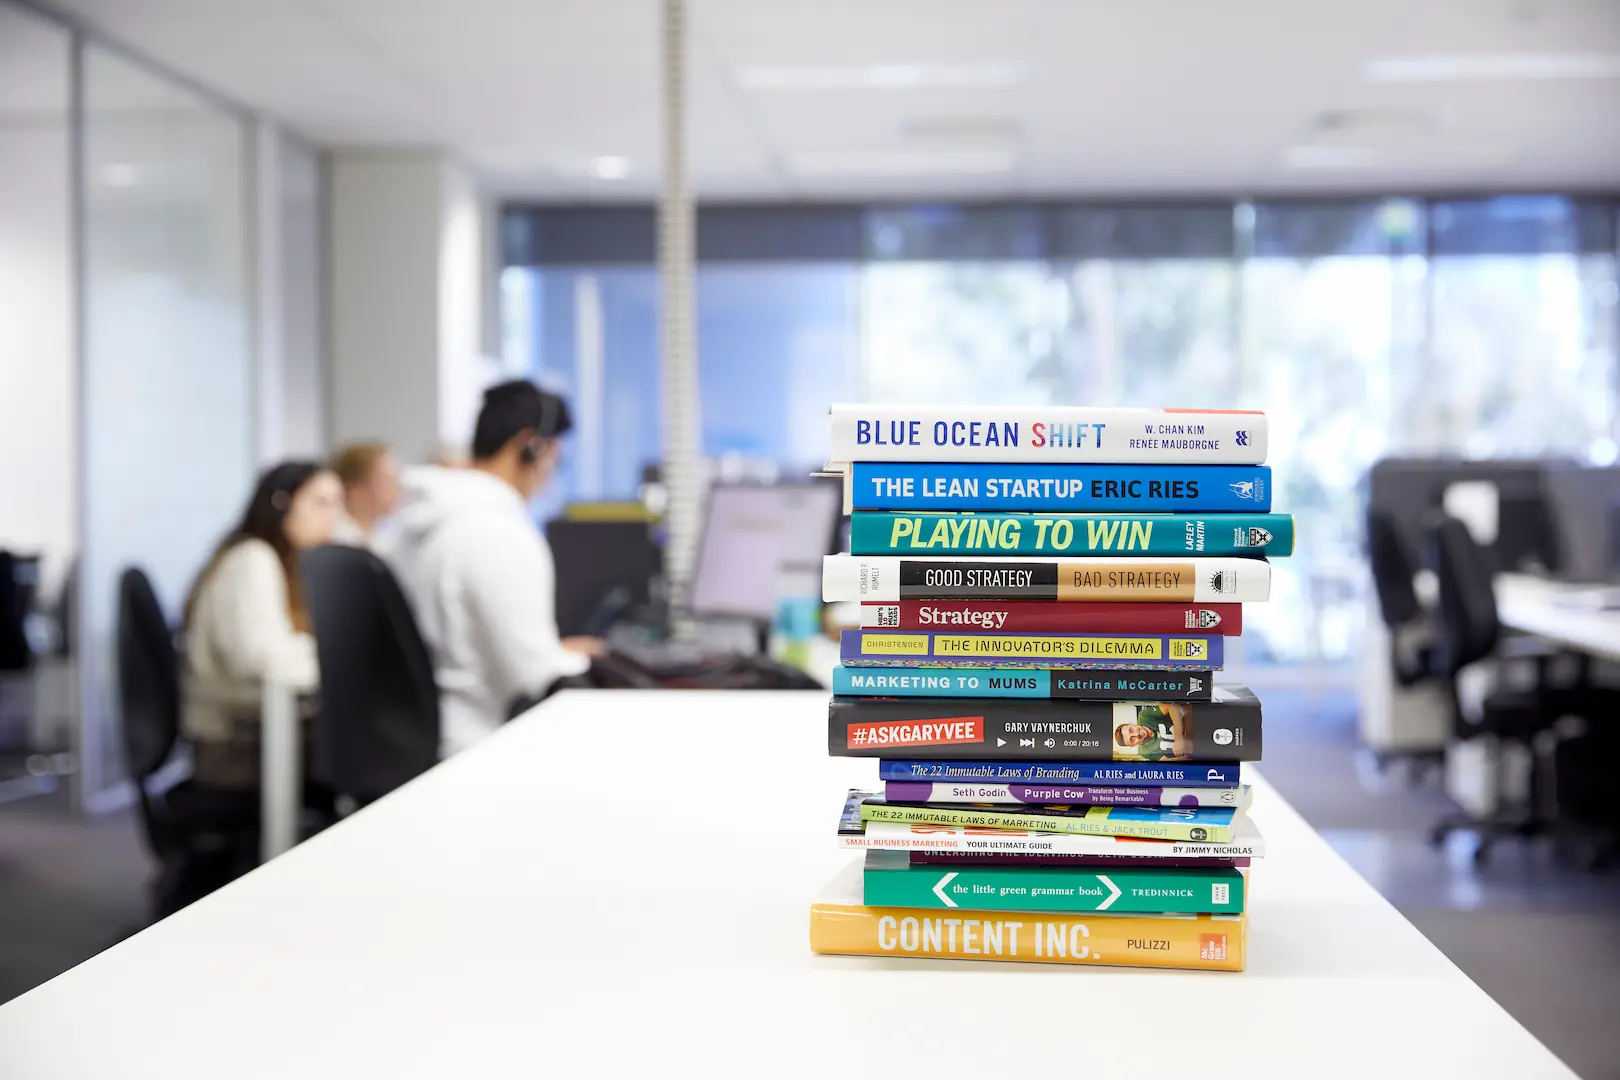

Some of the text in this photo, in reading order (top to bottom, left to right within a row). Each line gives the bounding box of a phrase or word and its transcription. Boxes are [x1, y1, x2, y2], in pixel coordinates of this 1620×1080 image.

[857, 420, 1106, 449] BLUE OCEAN SHIFT
[1144, 424, 1205, 435] W. CHAN KIM
[1161, 439, 1220, 450] MAUBORGNE
[872, 477, 1083, 498] THE LEAN STARTUP
[1091, 480, 1199, 499] ERIC RIES
[890, 518, 1153, 551] PLAYING TO WIN
[1185, 521, 1195, 551] LAFLEY
[1196, 521, 1205, 552] MARTIN
[860, 568, 868, 595] RICHARD
[871, 567, 880, 591] RUMELT
[925, 569, 1033, 587] GOOD STRATEGY
[1074, 571, 1181, 589] BAD STRATEGY
[883, 617, 888, 625] 10
[918, 606, 1008, 629] Strategy
[866, 640, 924, 648] CHRISTENSEN
[942, 639, 970, 651] THE
[1080, 642, 1154, 655] DILEMMA
[851, 676, 1037, 689] MARKETING TO MUMS
[1058, 679, 1183, 691] Katrina McCarter
[852, 721, 975, 745] #ASKGARYVEE
[1005, 722, 1092, 733] GARY VAYNERCHUK
[1063, 740, 1077, 748] 0:00
[911, 765, 1080, 781] The 22 Immutable Laws of Branding
[1094, 770, 1184, 780] AL RIES and LAURA RIES
[953, 788, 1007, 798] Seth Godin
[1024, 788, 1084, 800] Purple Cow
[1088, 787, 1113, 795] Transform
[1127, 788, 1149, 796] Business
[1092, 795, 1099, 803] by
[1100, 795, 1114, 803] Being
[871, 810, 1057, 830] THE 22 IMMUTABLE LAWS OF MARKETING
[1066, 823, 1168, 837] AL RIES & JACK TROUT
[845, 838, 958, 848] SMALL BUSINESS MARKETING
[990, 841, 1026, 850] ULTIMATE
[1029, 842, 1053, 850] GUIDE
[1185, 846, 1211, 854] JIMMY
[1213, 847, 1253, 855] NICHOLAS
[953, 884, 1103, 896] the little green grammar book
[1131, 889, 1194, 897] TREDINNICK
[878, 916, 1100, 959] CONTENT INC.
[1127, 939, 1170, 950] PULIZZI
[1201, 947, 1208, 959] Mc
